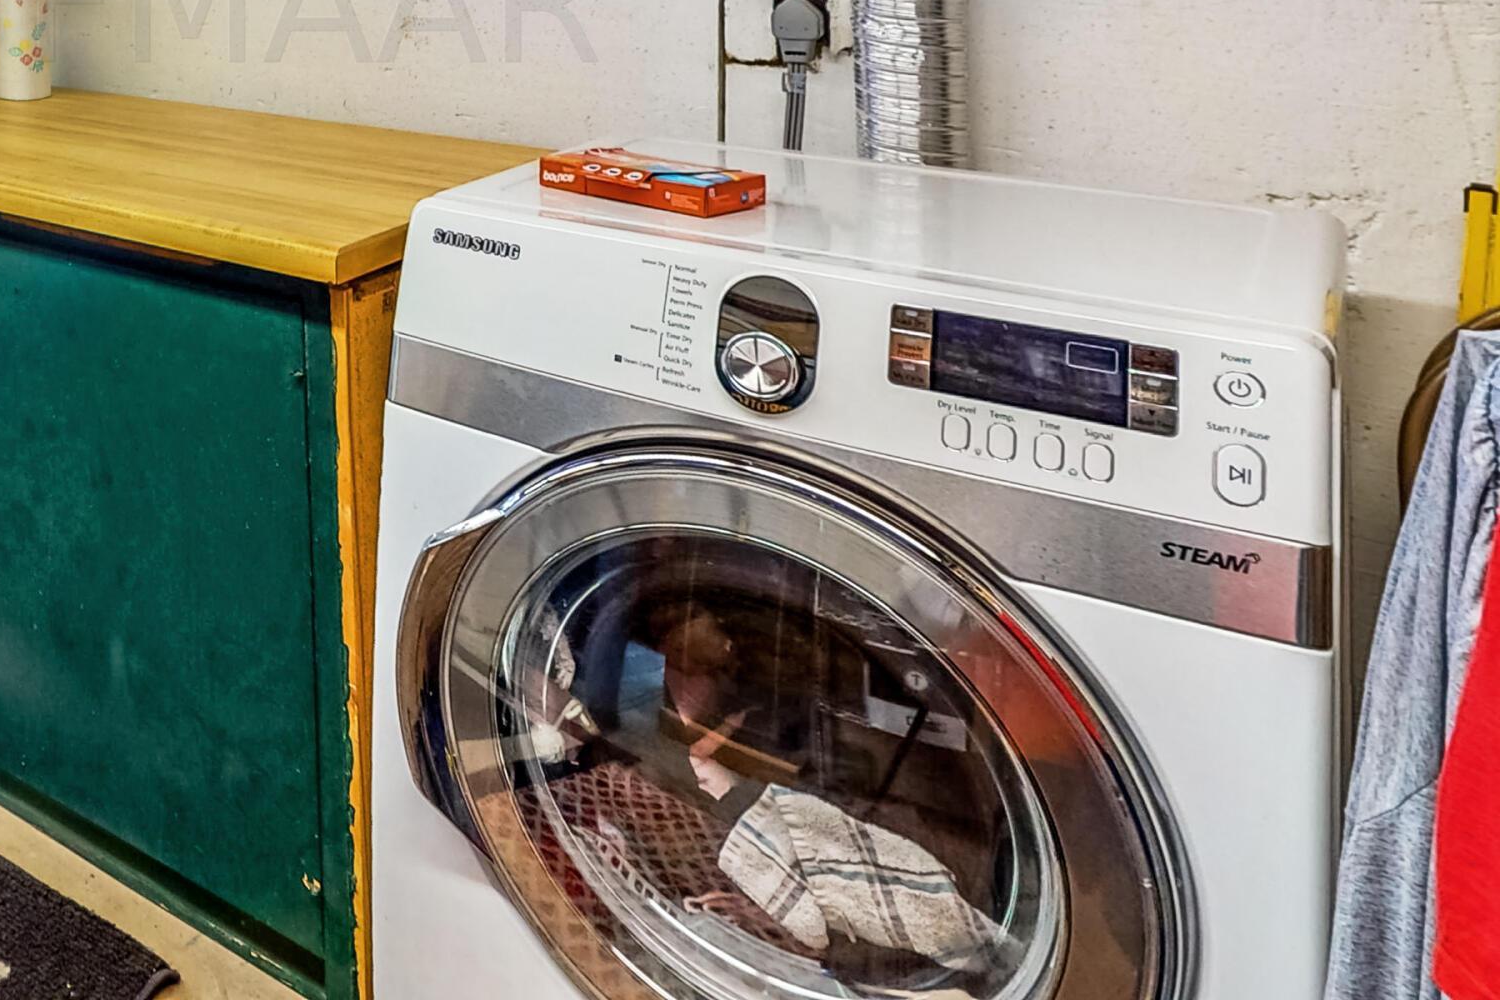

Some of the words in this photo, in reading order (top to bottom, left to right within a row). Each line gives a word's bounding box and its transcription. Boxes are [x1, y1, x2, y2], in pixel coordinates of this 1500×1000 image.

[432, 227, 521, 261] SAMSUNG
[674, 264, 697, 274] Normal
[1220, 352, 1252, 365] Power
[937, 399, 952, 413] Dry
[954, 402, 977, 416] Level
[989, 410, 1016, 424] Temp.
[1039, 419, 1061, 432] Time
[1206, 421, 1231, 435] Start
[1240, 426, 1271, 442] Pause
[1084, 427, 1114, 443] Signal
[1159, 541, 1252, 575] STEAM
